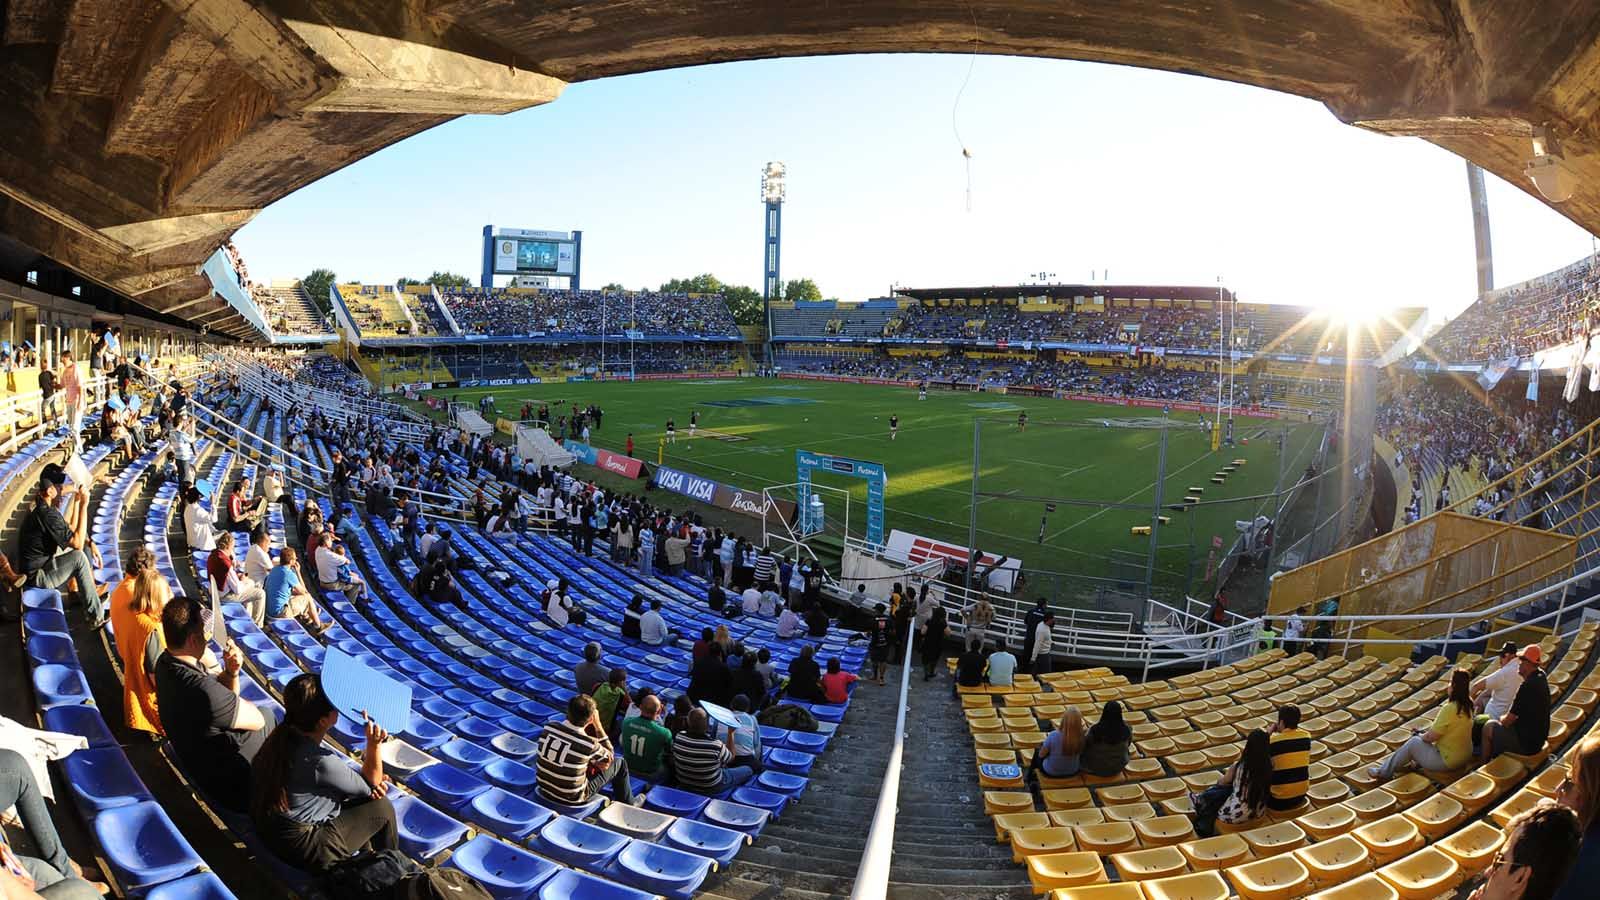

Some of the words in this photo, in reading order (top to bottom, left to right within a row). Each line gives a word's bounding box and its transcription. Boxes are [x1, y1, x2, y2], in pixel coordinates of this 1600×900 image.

[658, 470, 684, 491] VISA
[687, 477, 714, 501] VISA
[730, 492, 771, 515] Personal
[543, 735, 570, 765] H
[630, 734, 646, 757] 11
